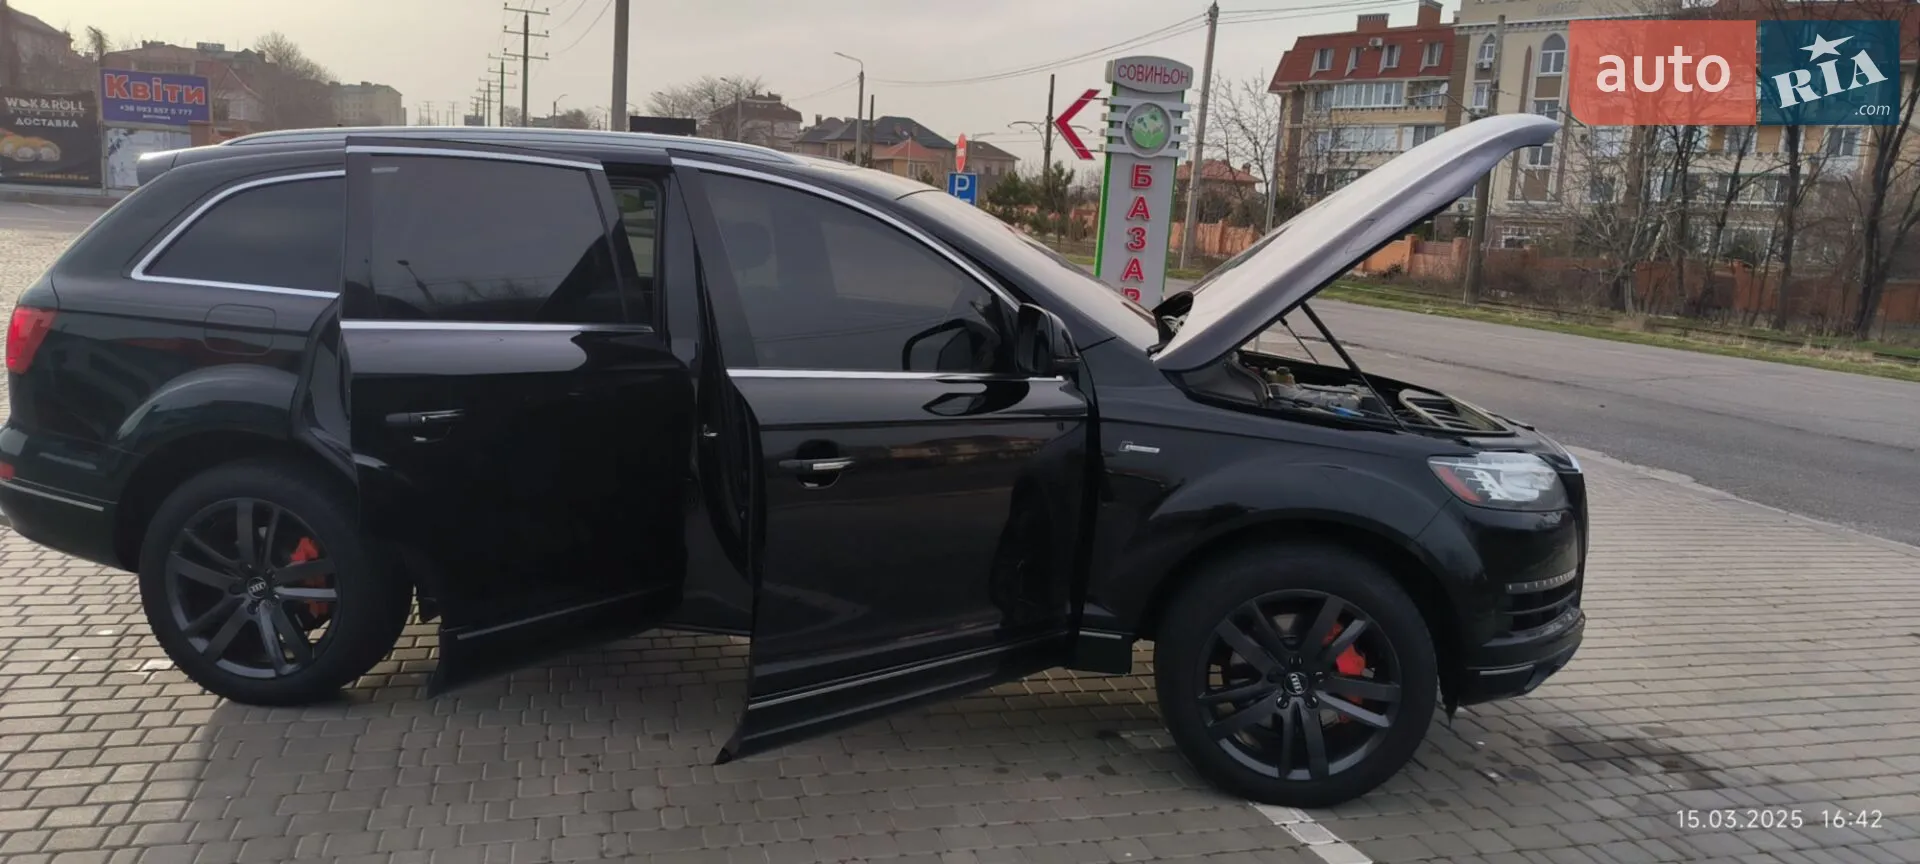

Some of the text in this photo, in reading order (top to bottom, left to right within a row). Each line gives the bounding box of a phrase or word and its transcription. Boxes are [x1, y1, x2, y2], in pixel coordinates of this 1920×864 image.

[1117, 64, 1189, 85] СОВИНЬОН
[104, 73, 206, 106] Квіти
[15, 117, 79, 128] ДОСТАВКА
[954, 174, 970, 196] P
